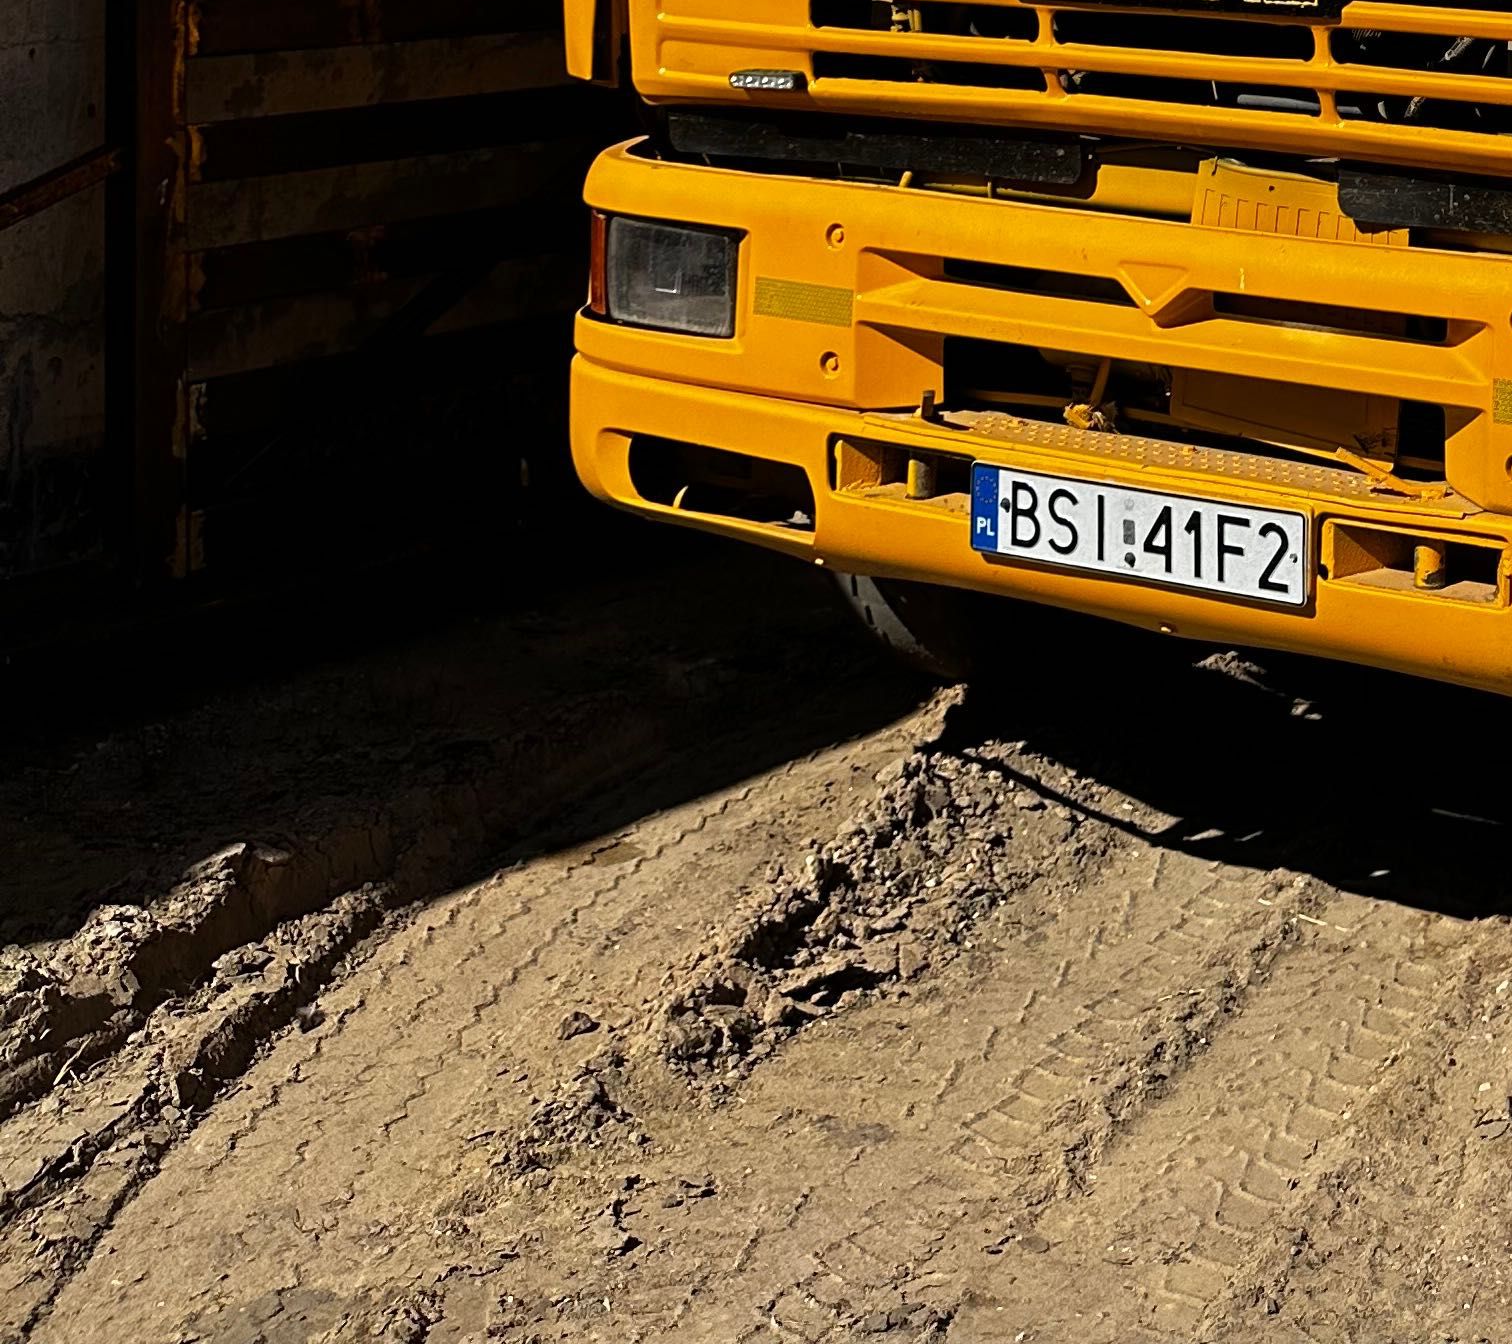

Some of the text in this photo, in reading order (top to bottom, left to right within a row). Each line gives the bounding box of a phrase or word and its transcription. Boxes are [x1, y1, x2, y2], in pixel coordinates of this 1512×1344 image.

[976, 516, 995, 537] PL
[1011, 480, 1290, 594] BSI 41F2
